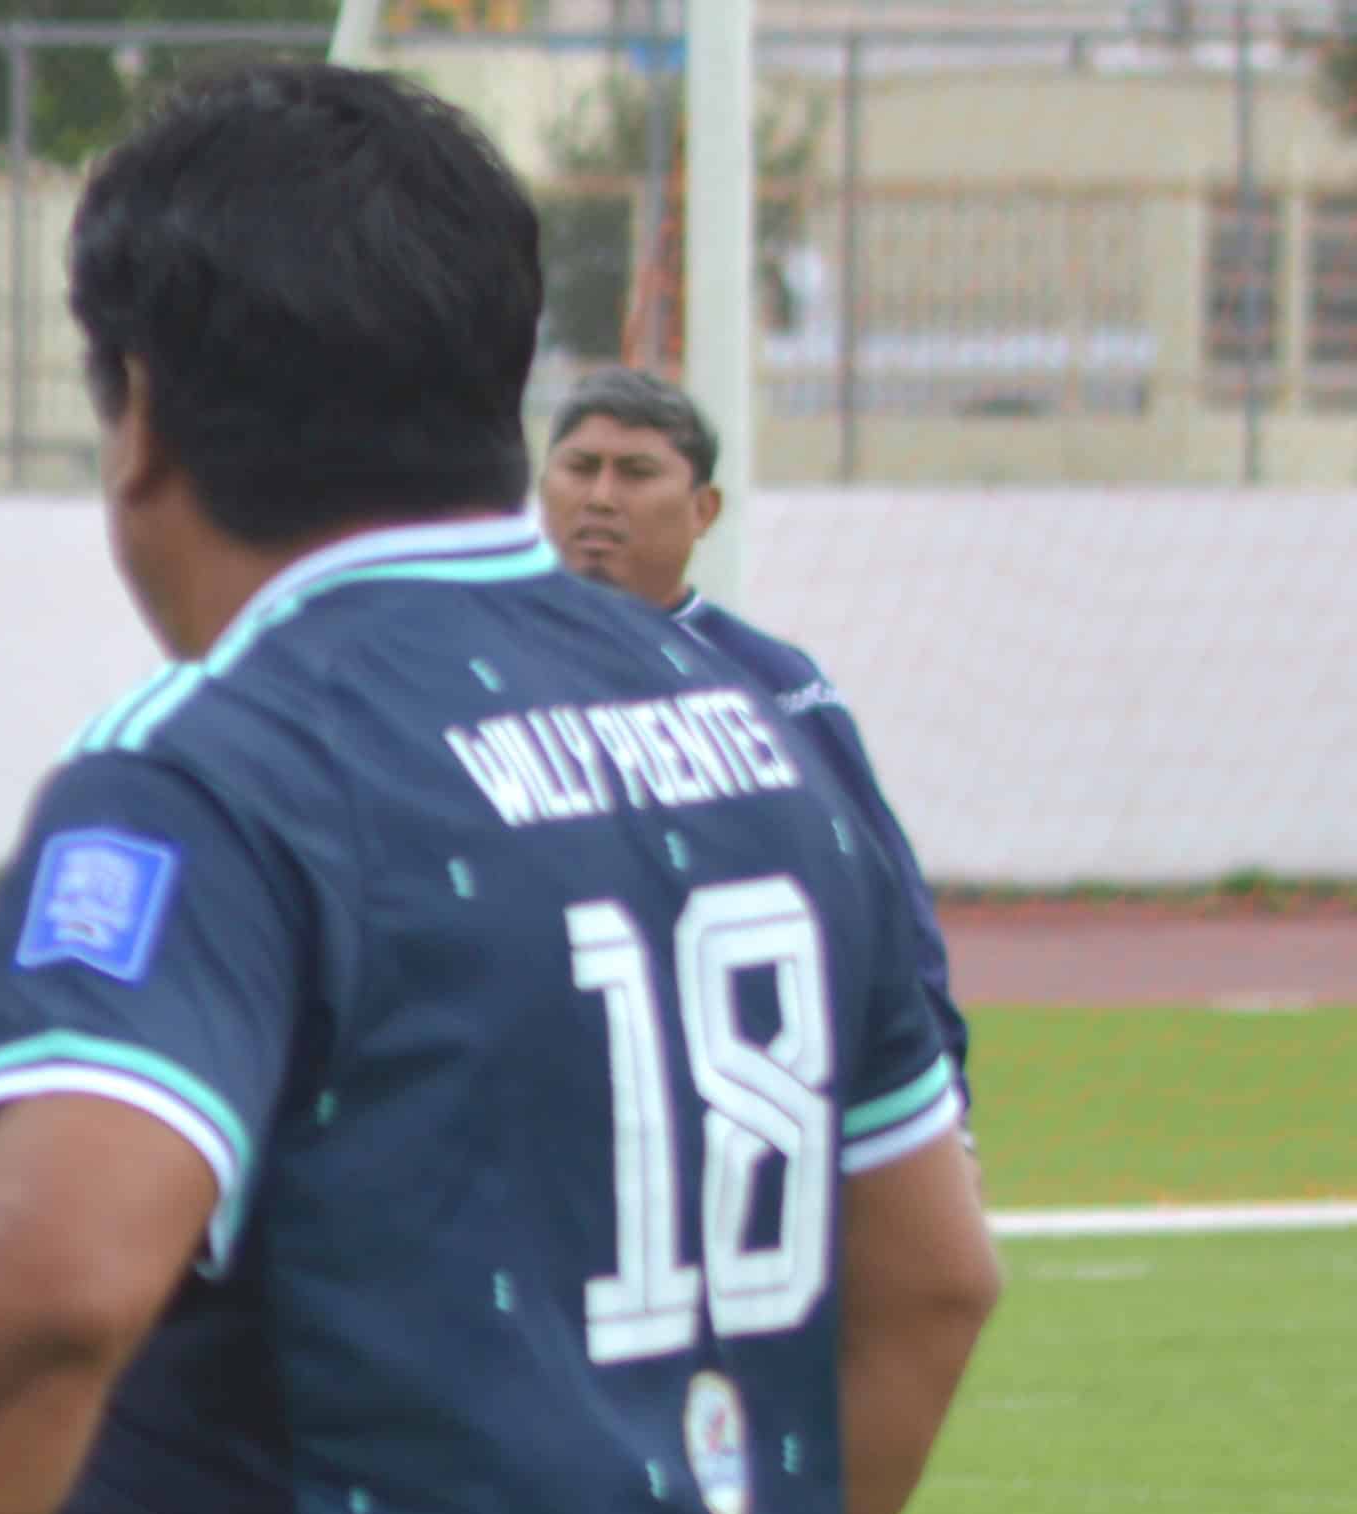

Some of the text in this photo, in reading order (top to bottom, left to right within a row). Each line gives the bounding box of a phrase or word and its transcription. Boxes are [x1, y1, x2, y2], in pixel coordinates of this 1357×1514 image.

[444, 690, 799, 828] WILLY PUENTES
[564, 872, 833, 1365] 18
